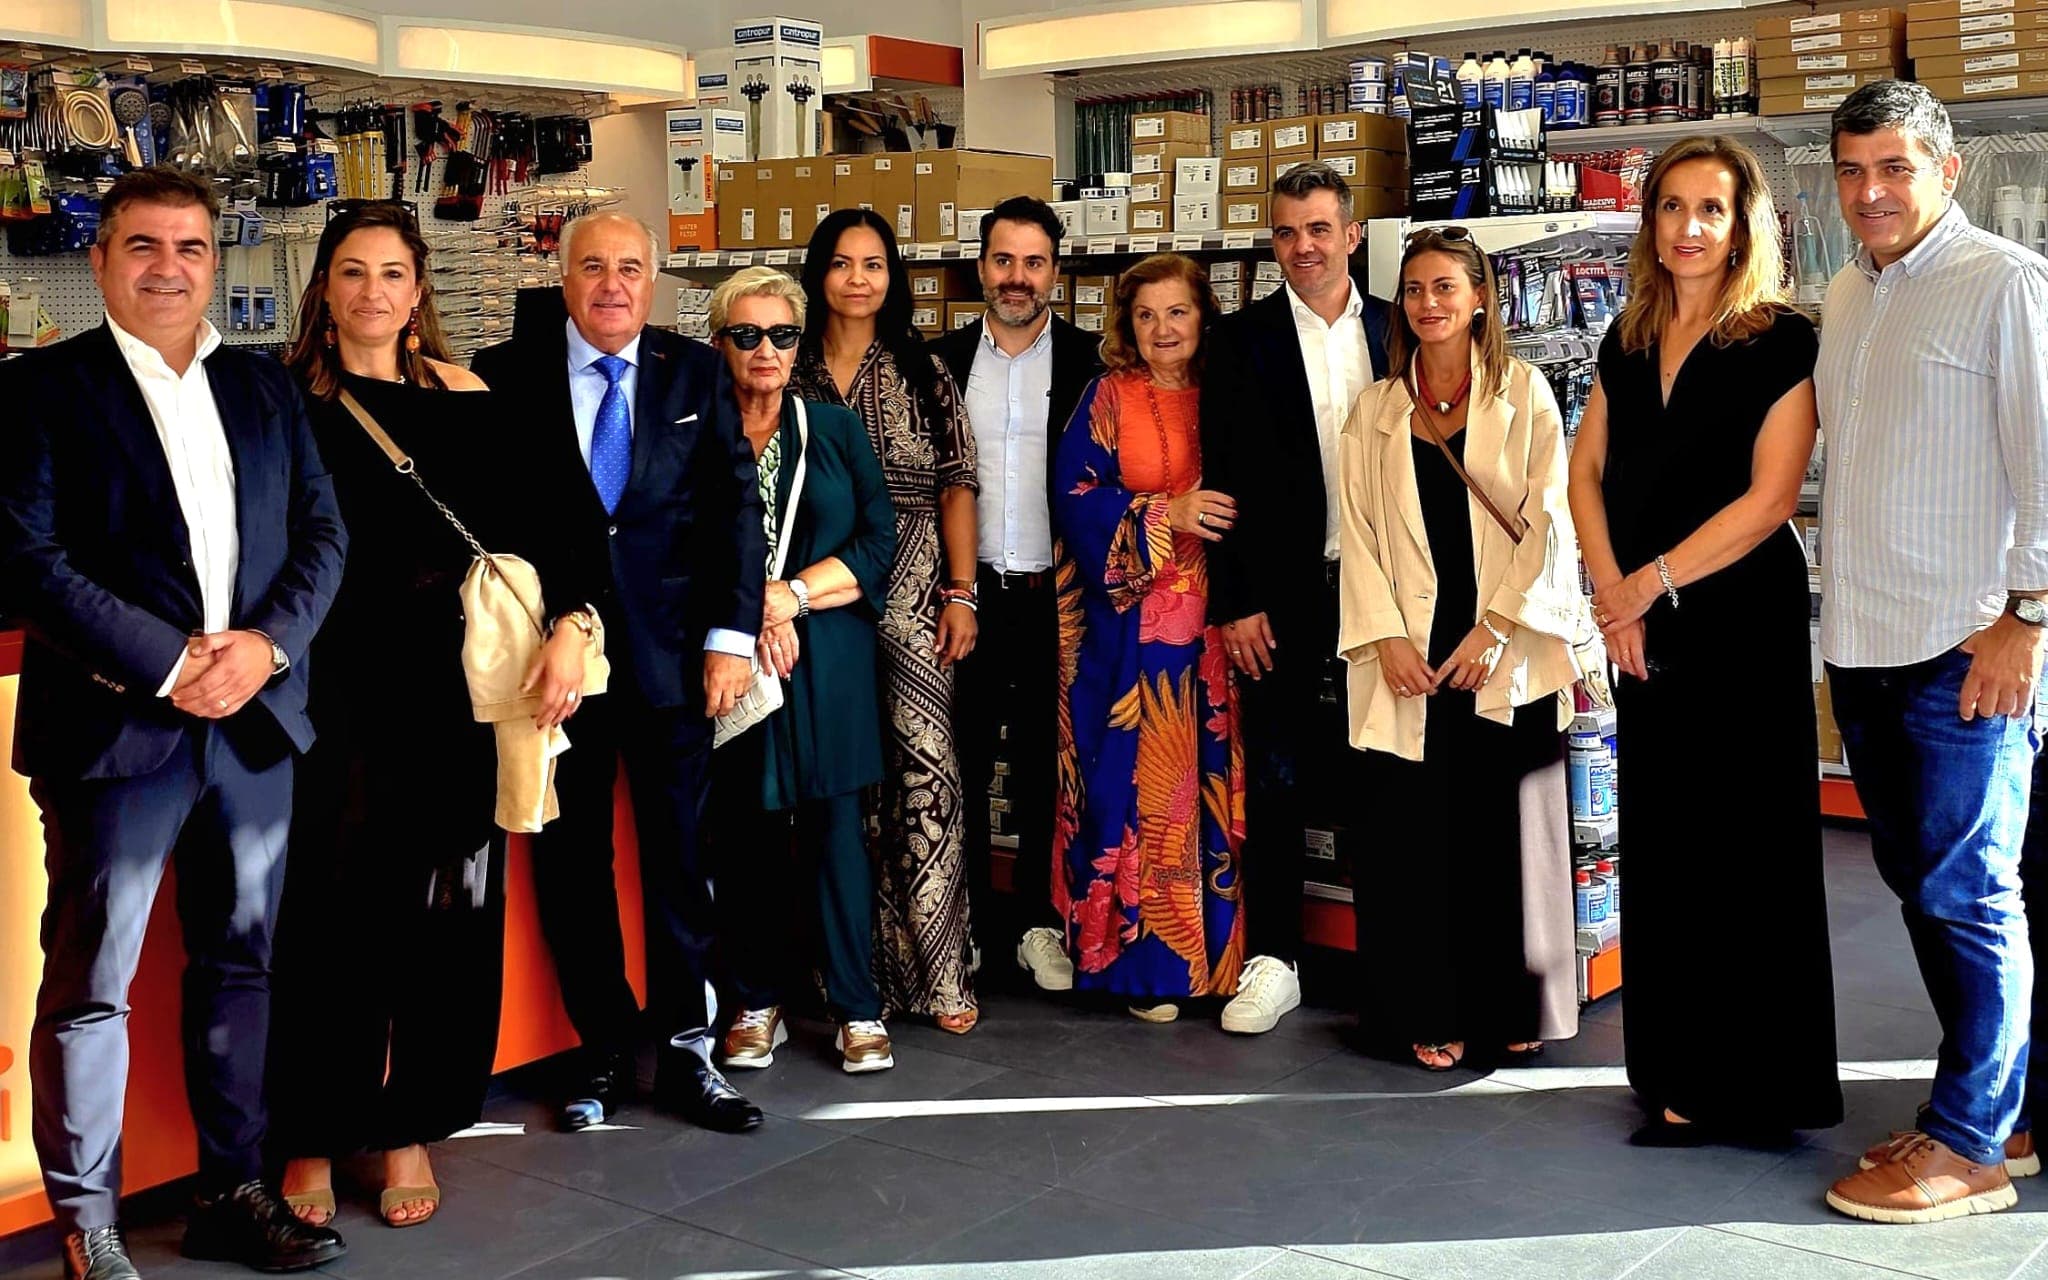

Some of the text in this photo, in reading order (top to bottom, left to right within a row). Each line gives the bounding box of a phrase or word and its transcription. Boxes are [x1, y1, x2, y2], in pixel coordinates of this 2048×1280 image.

[1626, 70, 1649, 78] MELT
[1462, 110, 1481, 123] 21
[1461, 167, 1480, 180] 21
[1576, 267, 1606, 275] LOCTITE
